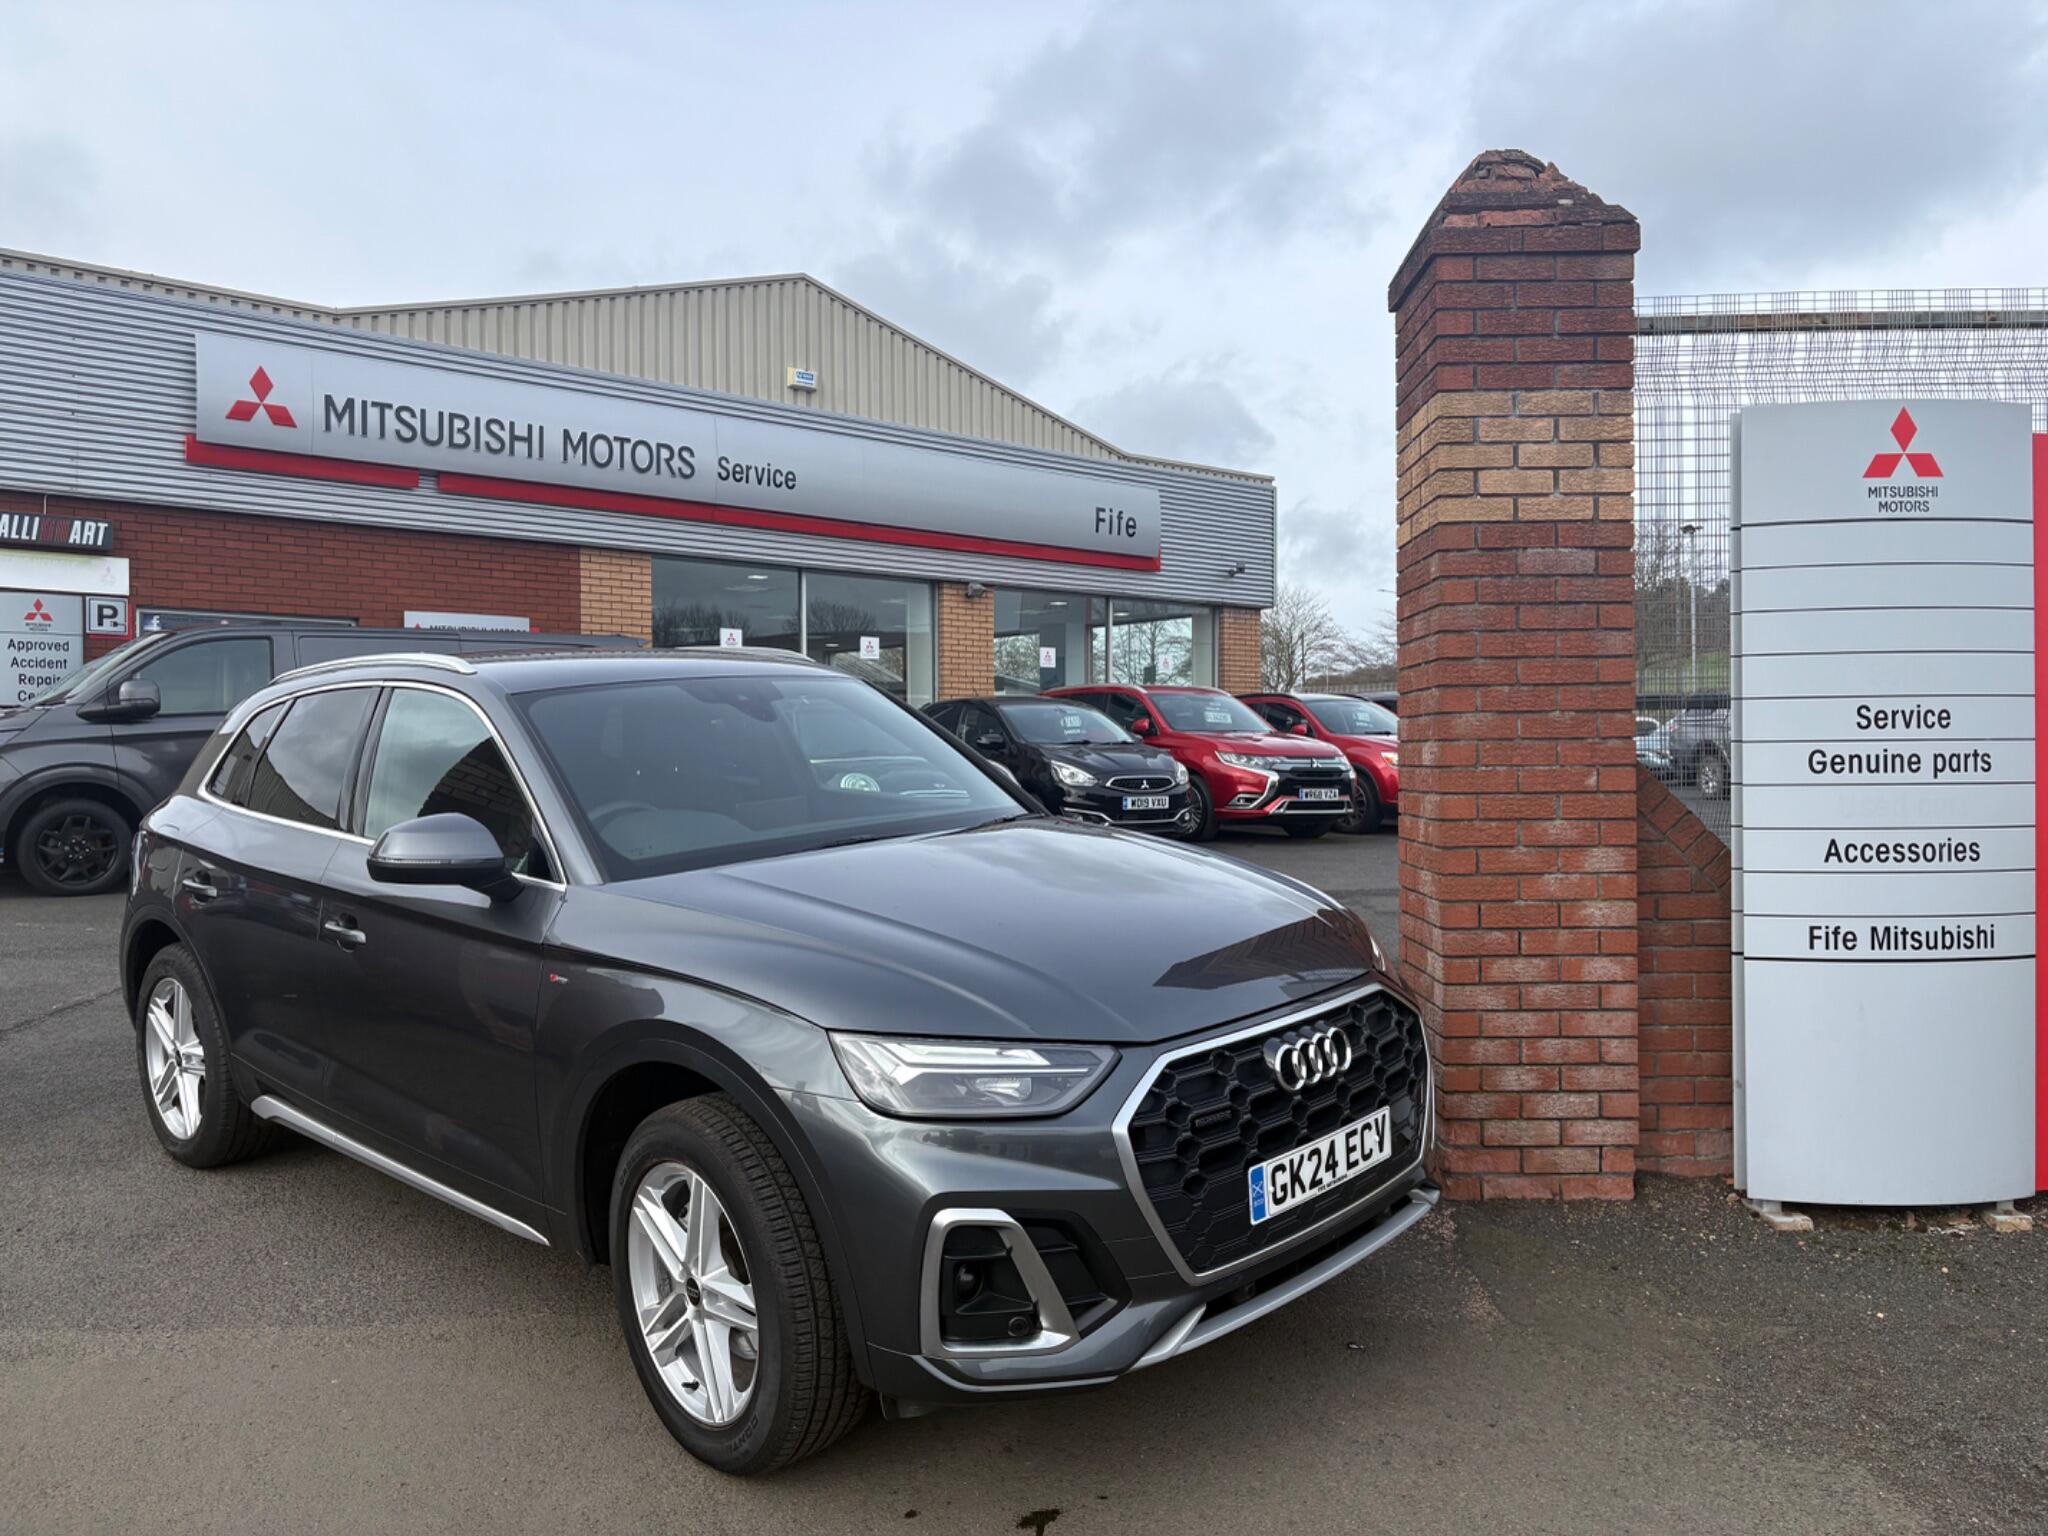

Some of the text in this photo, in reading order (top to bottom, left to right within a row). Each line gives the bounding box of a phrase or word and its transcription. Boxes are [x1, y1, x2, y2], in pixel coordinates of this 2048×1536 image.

[323, 394, 697, 479] MITSUBISHI MOTORS
[717, 456, 797, 490] Service
[1868, 486, 1939, 498] MITSUBISHI
[1878, 500, 1930, 513] MOTORS
[1095, 506, 1137, 538] Fife
[97, 604, 118, 627] P
[8, 638, 70, 653] Approved
[10, 657, 68, 670] Accident
[1856, 704, 1951, 730] Service
[1808, 749, 1992, 779] Genuine parts
[1824, 838, 1981, 864] Accessories
[1808, 925, 1996, 951] Fife Mitsubishi
[1270, 1113, 1387, 1207] GK24 ECV
